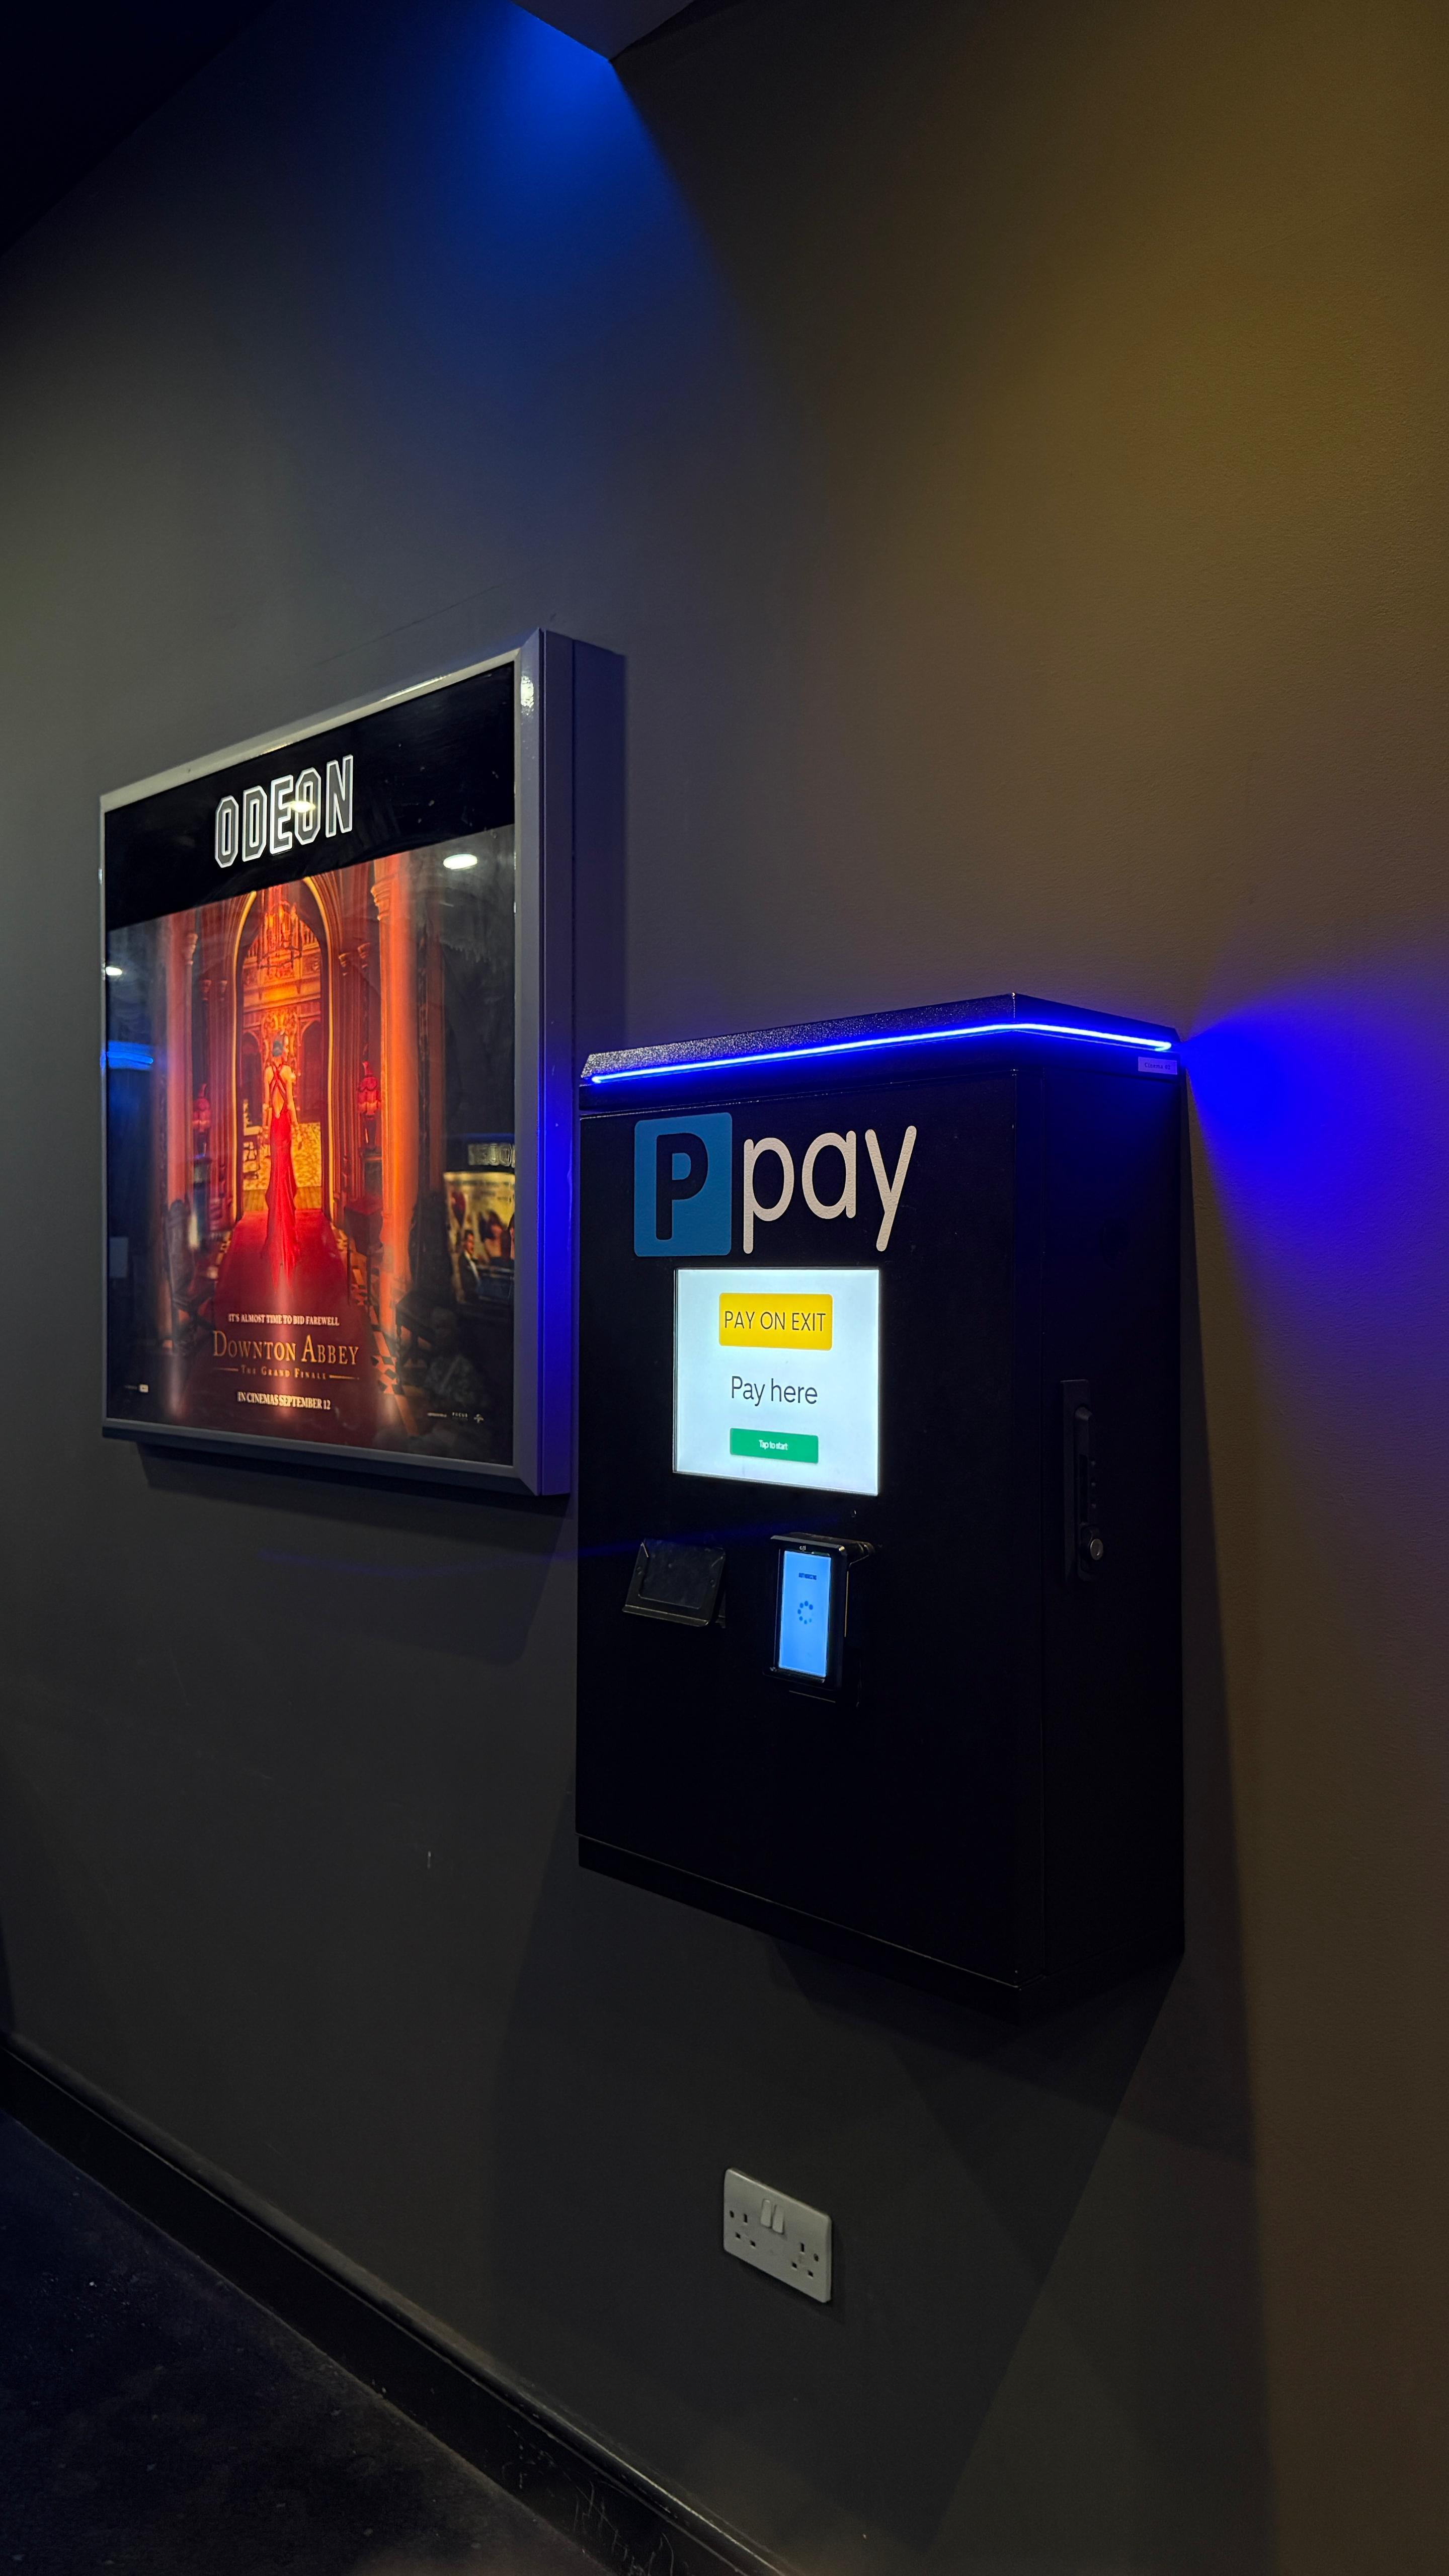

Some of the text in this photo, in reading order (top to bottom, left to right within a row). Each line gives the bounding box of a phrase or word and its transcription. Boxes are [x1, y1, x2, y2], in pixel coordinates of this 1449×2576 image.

[214, 754, 354, 869] ODEON
[656, 1125, 917, 1254] P pay
[228, 1313, 340, 1326] IT'S ALMOST TIME TO BID FAREWELL
[725, 1311, 826, 1331] PAY ON EXIT
[212, 1330, 359, 1365] DOWNTON ABBEY
[237, 1391, 331, 1410] IN CINEMAS SEPTEMBER 12
[731, 1376, 818, 1407] Pay here
[759, 1439, 788, 1451] Tap to start
